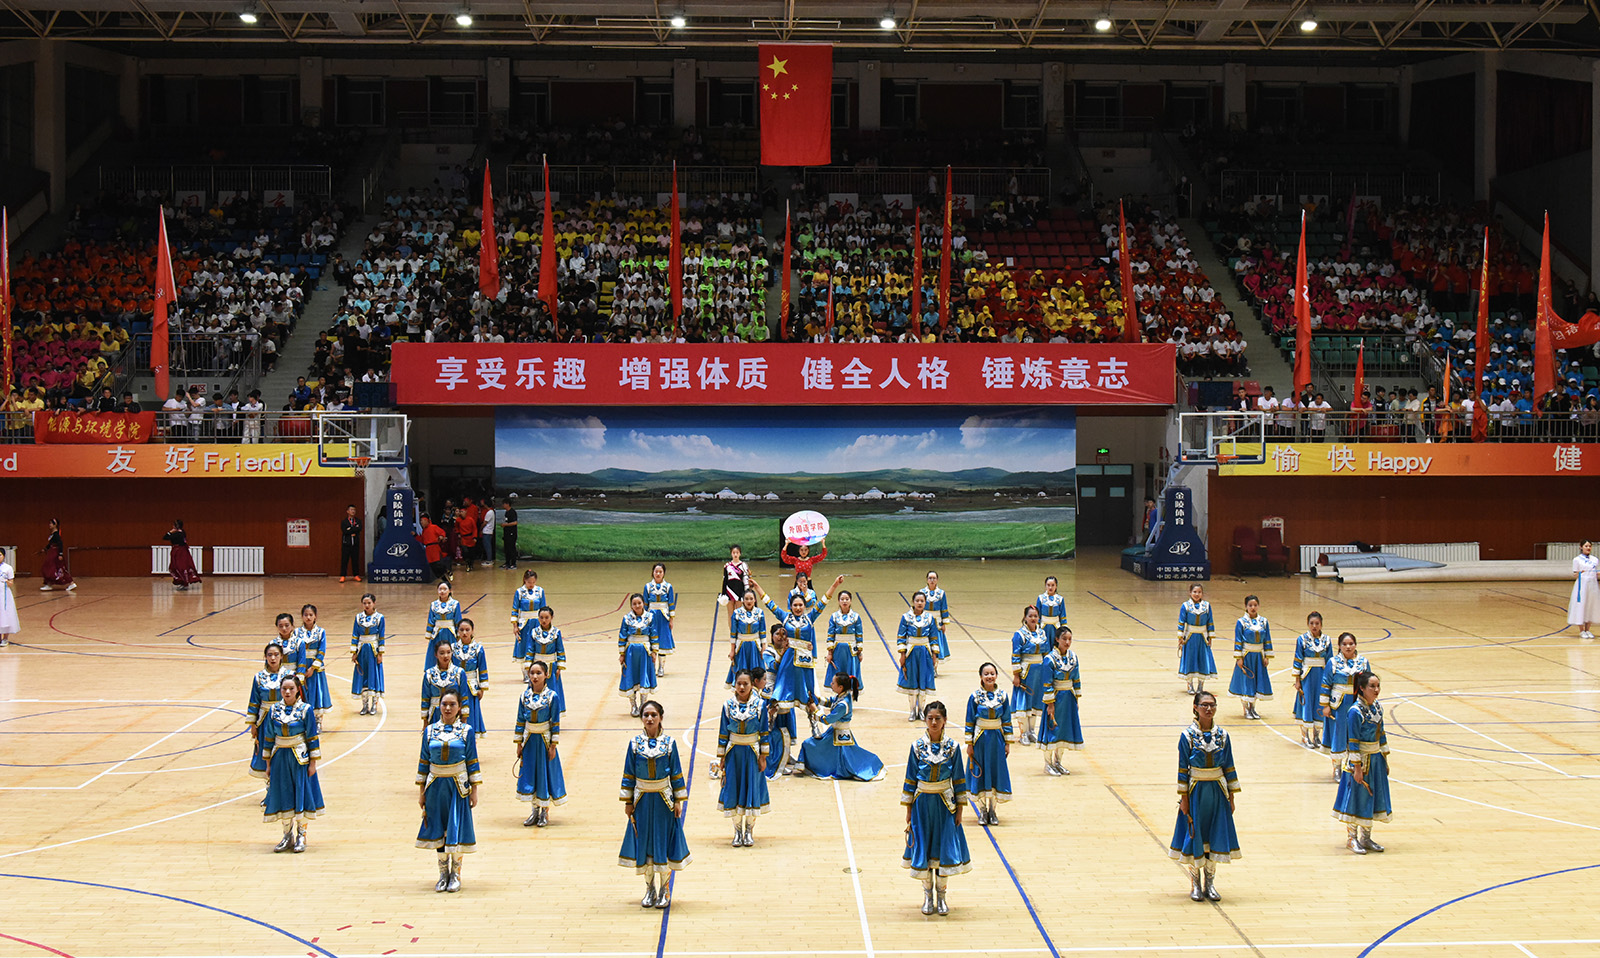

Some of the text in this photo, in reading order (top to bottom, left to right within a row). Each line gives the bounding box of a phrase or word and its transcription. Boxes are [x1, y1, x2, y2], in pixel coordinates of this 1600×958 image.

[435, 356, 1130, 391] 享受乐趣 增强体质 健全人格 锤炼意志
[47, 416, 141, 440] 能源与环境学院
[204, 452, 311, 474] Friendly
[1368, 451, 1432, 473] Happy
[1553, 445, 1582, 471] 健
[393, 493, 403, 526] 金陵体育
[1175, 492, 1185, 525] 金陵体育
[789, 522, 824, 534] 外国语学院
